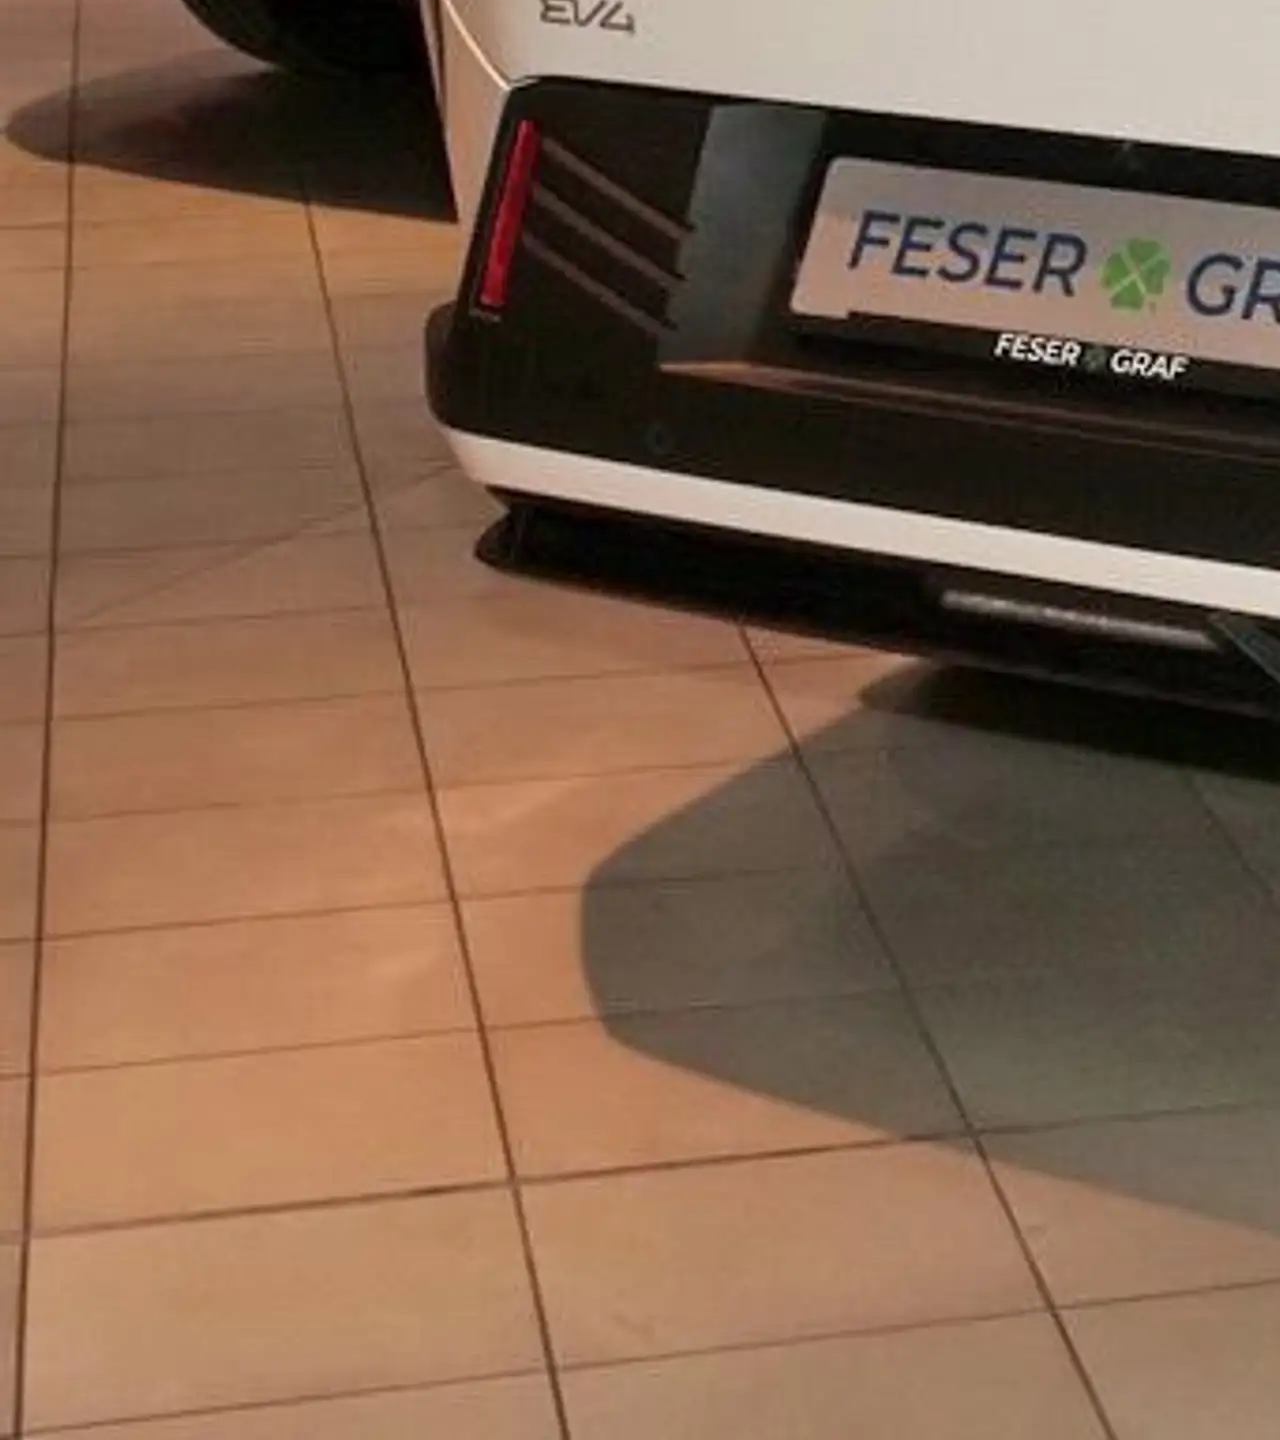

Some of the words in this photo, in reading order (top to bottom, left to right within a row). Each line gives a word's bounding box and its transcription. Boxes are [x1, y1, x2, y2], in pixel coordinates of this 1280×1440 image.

[847, 209, 1089, 298] FESER
[993, 332, 1082, 368] FESER
[1109, 347, 1192, 381] GRAF
